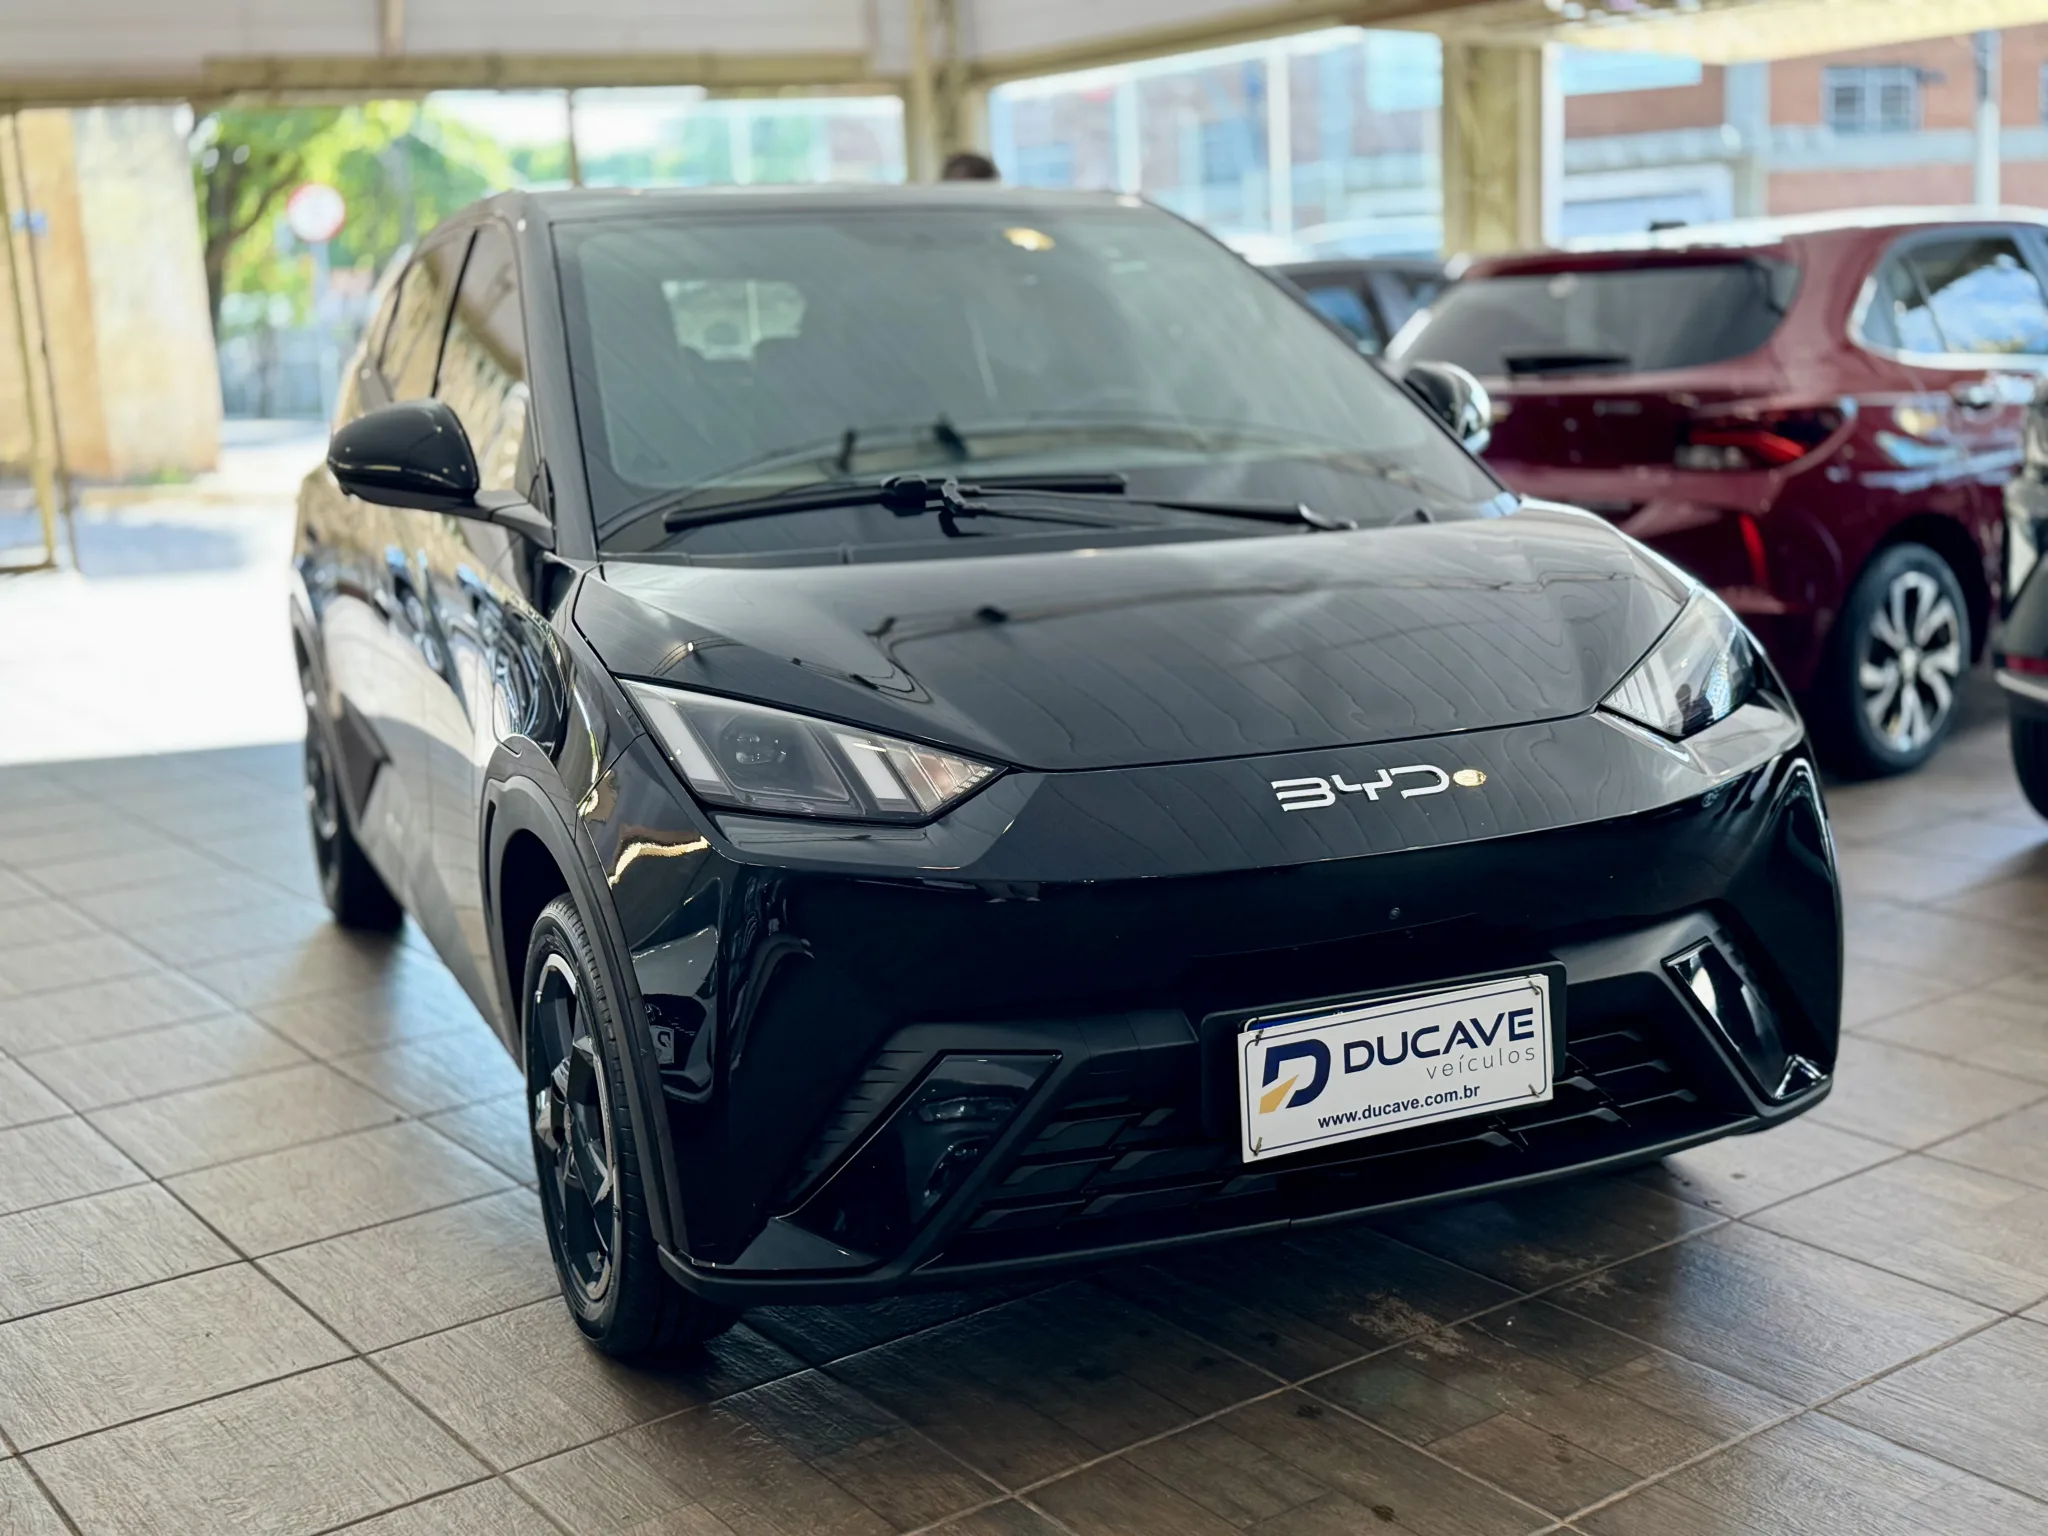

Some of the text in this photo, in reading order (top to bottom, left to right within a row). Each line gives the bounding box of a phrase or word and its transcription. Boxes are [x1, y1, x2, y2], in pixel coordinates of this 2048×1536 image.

[1270, 764, 1450, 812] BYD
[1343, 1007, 1536, 1075] DUCAVE
[1425, 1045, 1536, 1080] veículos
[1317, 1084, 1481, 1129] www.ducave.com.br
